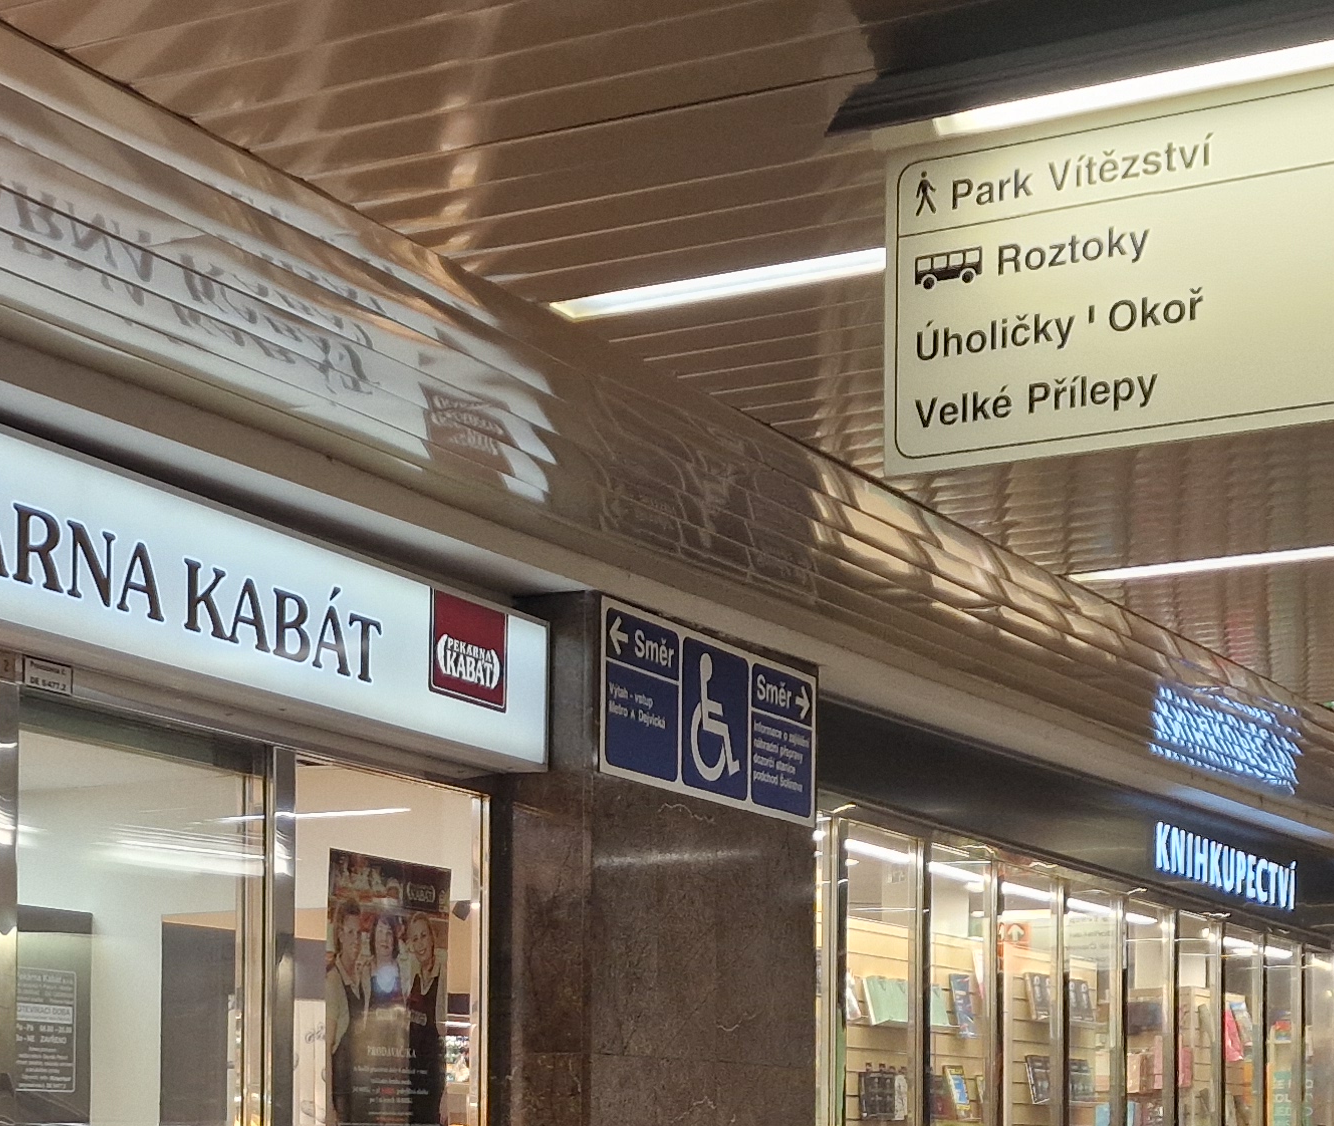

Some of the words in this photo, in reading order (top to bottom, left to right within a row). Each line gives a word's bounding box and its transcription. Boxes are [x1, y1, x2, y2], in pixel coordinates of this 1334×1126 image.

[951, 168, 1033, 210] Park
[1048, 132, 1215, 191] Vítězství
[998, 226, 1150, 276] Roztoky
[916, 313, 1075, 361] Úholičky
[1108, 286, 1204, 332] Okoř
[914, 384, 1012, 428] Velké
[1027, 373, 1158, 414] Přílepy
[183, 556, 383, 684] KABÁT
[634, 628, 675, 669] Směr
[756, 673, 792, 709] Směr
[1155, 821, 1298, 912] KNIHKUPECTVÍ
